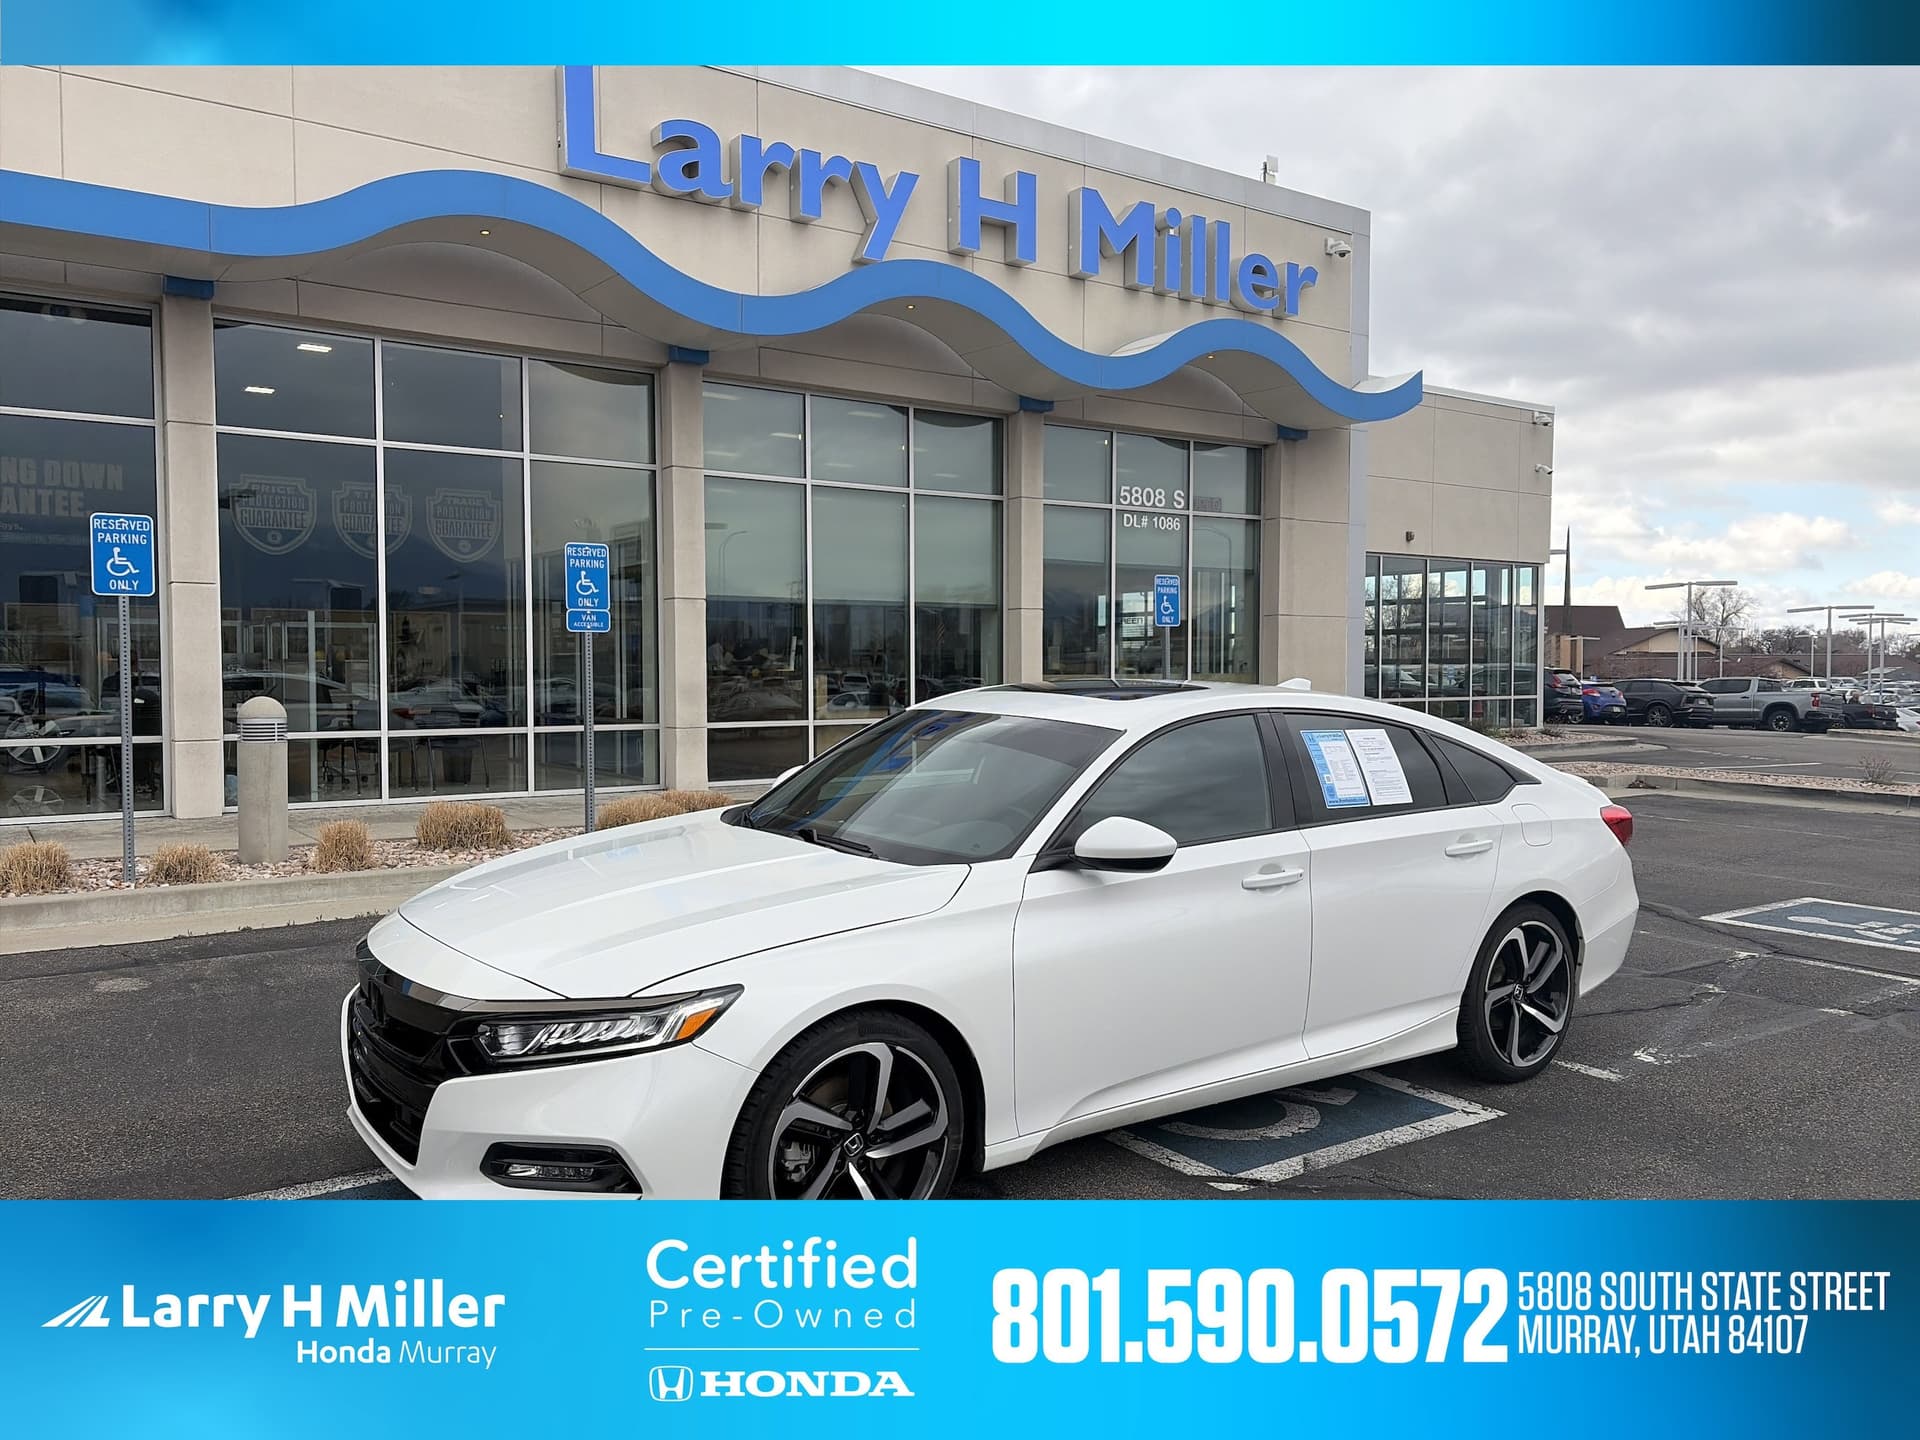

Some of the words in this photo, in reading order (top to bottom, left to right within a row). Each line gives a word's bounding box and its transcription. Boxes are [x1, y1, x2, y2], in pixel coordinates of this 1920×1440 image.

[558, 66, 919, 264] Larry
[948, 156, 1038, 266] H
[1068, 187, 1318, 319] Miller
[43, 459, 124, 491] DOWN
[1119, 486, 1165, 507] 5808
[1173, 489, 1185, 509] S
[94, 518, 150, 531] RESERVED
[240, 507, 309, 531] GUARANTEE
[1123, 513, 1148, 529] DL#
[1152, 515, 1181, 532] 1086
[97, 532, 147, 545] PARKING
[568, 547, 606, 558] RESERVED
[570, 559, 604, 568] PARKING
[109, 579, 139, 591] ONLY
[1157, 578, 1178, 586] RESERVED
[1157, 586, 1178, 594] PARKING
[578, 598, 598, 607] ONLY
[582, 614, 596, 622] VAN
